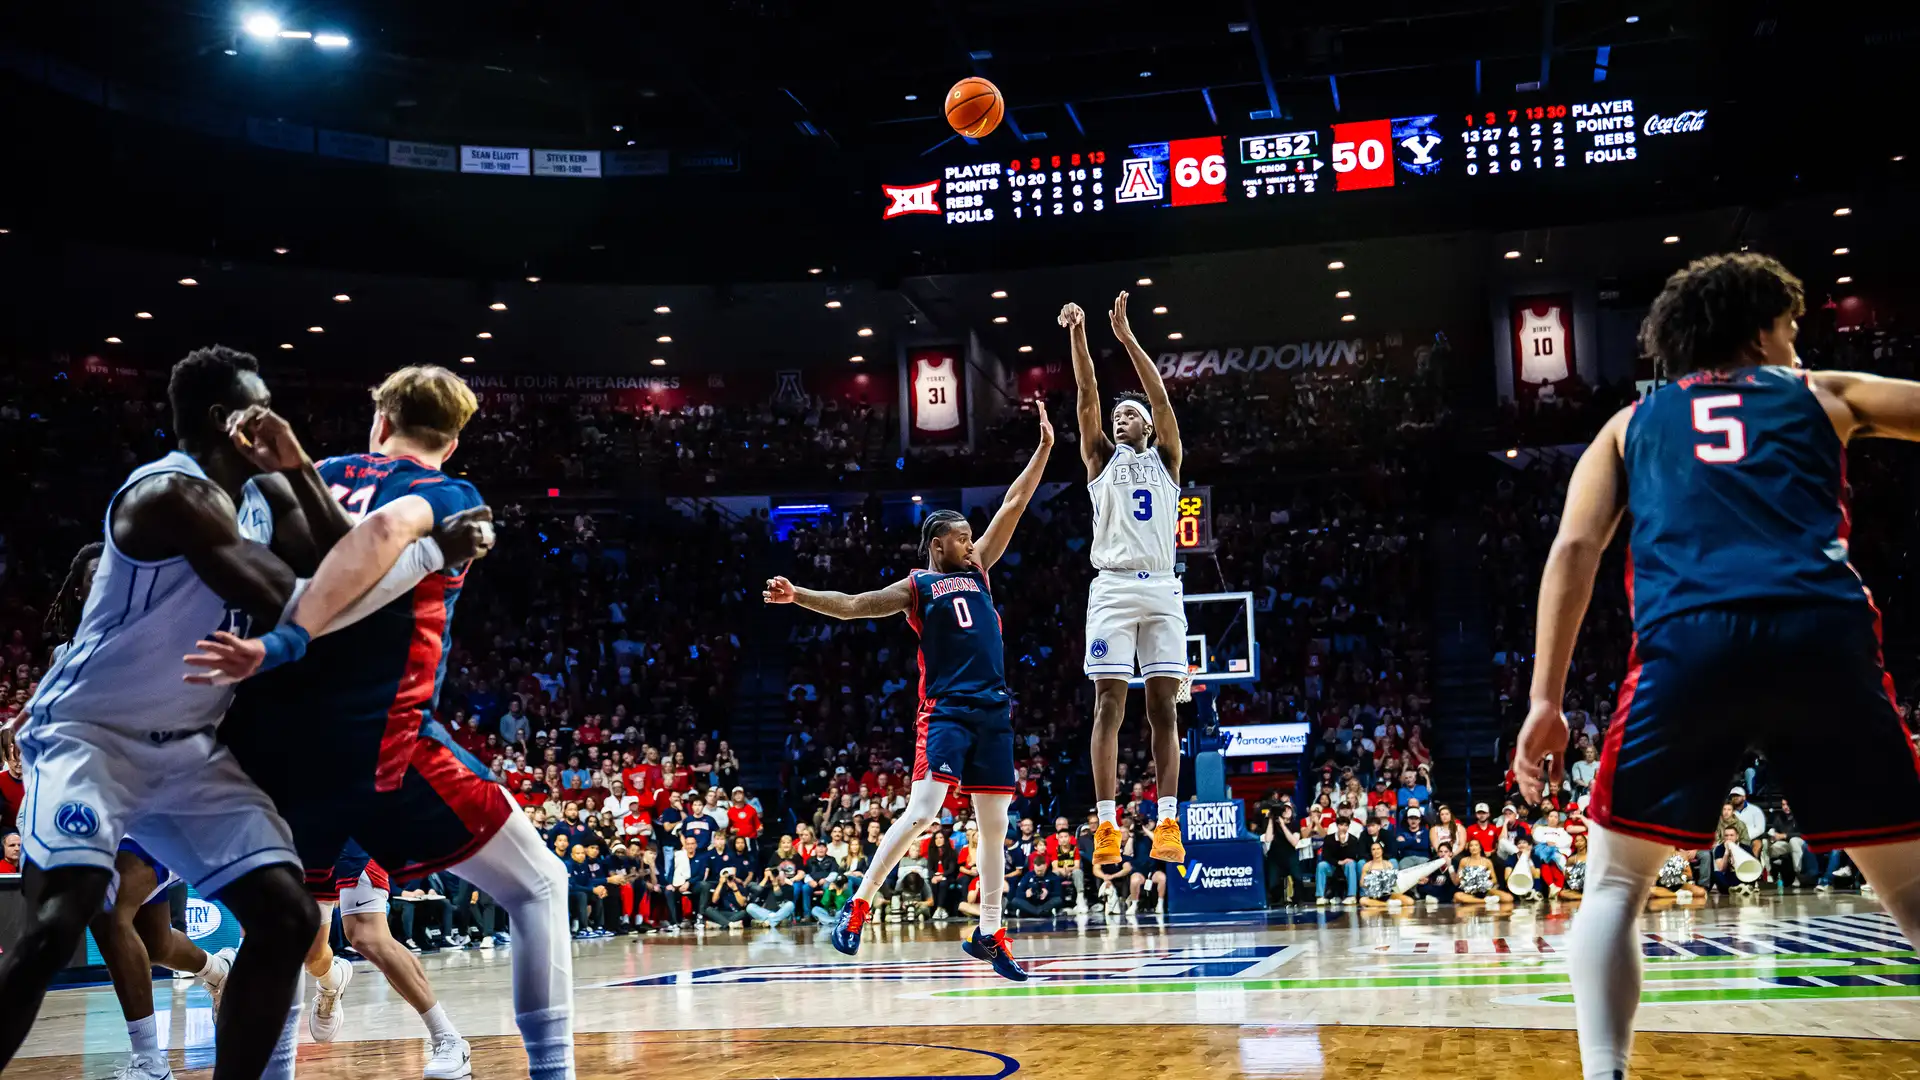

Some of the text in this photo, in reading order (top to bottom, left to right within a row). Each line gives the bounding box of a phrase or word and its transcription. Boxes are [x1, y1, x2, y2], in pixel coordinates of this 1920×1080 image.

[1466, 114, 1473, 126] 1
[1507, 110, 1518, 122] 7
[1546, 104, 1566, 118] 30
[1572, 100, 1633, 118] PLAYER
[1643, 110, 1708, 136] Coca-Cola
[1461, 115, 1634, 143] 13 27 4 2 2 POINTS
[472, 150, 520, 160] SEAN ELLIOTT
[546, 153, 568, 162] STEVE
[1250, 135, 1310, 160] 5:52
[1332, 139, 1385, 172] 50
[1401, 134, 1442, 164] Y
[1466, 132, 1636, 158] 2 6 2 7 2 REBS
[945, 162, 1000, 179] PLAYER
[1010, 160, 1021, 171] 0
[1088, 151, 1105, 164] 13
[1174, 156, 1227, 188] 66
[1466, 147, 1637, 176] 0 2 0 1 2 FOULS
[946, 168, 1102, 194] POINTS 10 20 8 16 5
[1116, 158, 1164, 203] A
[1246, 180, 1315, 198] 3 3 2 2
[946, 183, 1103, 210] REBS 3 4 2 6 6
[947, 199, 1104, 224] FOULS 1 1 2 0 3
[1534, 338, 1553, 356] 10
[564, 376, 680, 390] APPEARANCES
[928, 387, 946, 404] 31
[1690, 392, 1747, 464] 5
[1113, 463, 1161, 487] BYU
[1132, 489, 1153, 521] 3
[1176, 516, 1198, 547] 0
[931, 576, 980, 599] ARIZONA
[952, 597, 973, 628] 0
[1236, 734, 1306, 745] Vantage West
[1187, 805, 1238, 825] ROCKIN'
[1188, 823, 1237, 840] PROTEIN
[1201, 877, 1232, 888] West
[1202, 866, 1253, 877] Vantage
